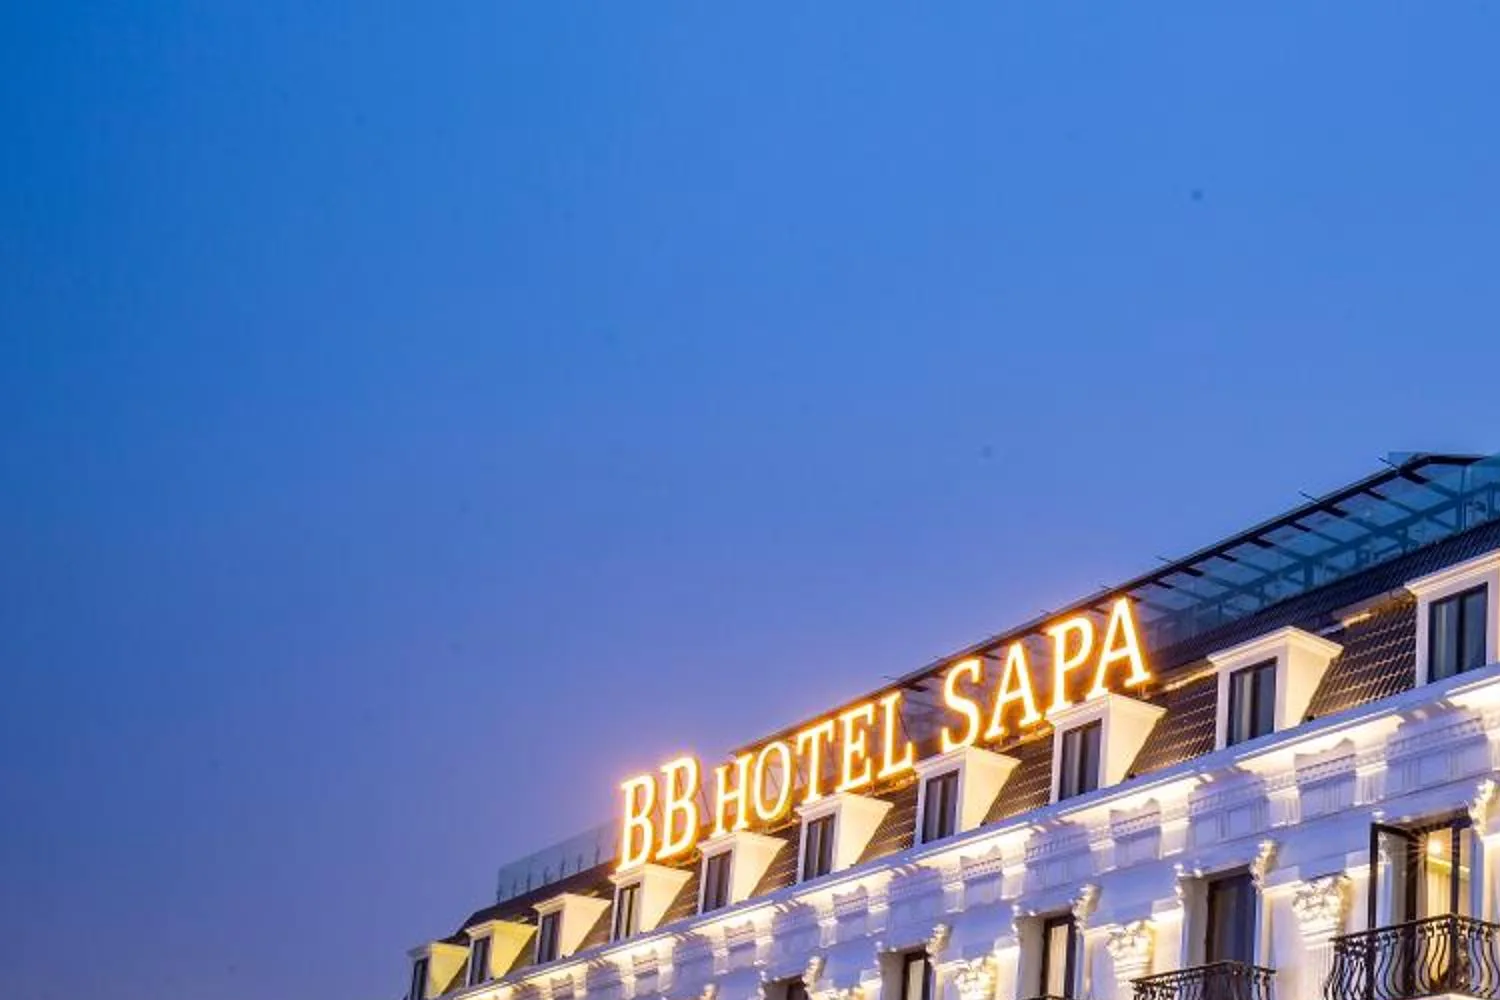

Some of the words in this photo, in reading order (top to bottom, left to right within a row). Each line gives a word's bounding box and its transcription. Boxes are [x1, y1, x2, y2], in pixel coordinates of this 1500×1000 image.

[617, 755, 699, 870] BB
[712, 691, 915, 837] HOTEL
[941, 597, 1152, 753] SAPA
